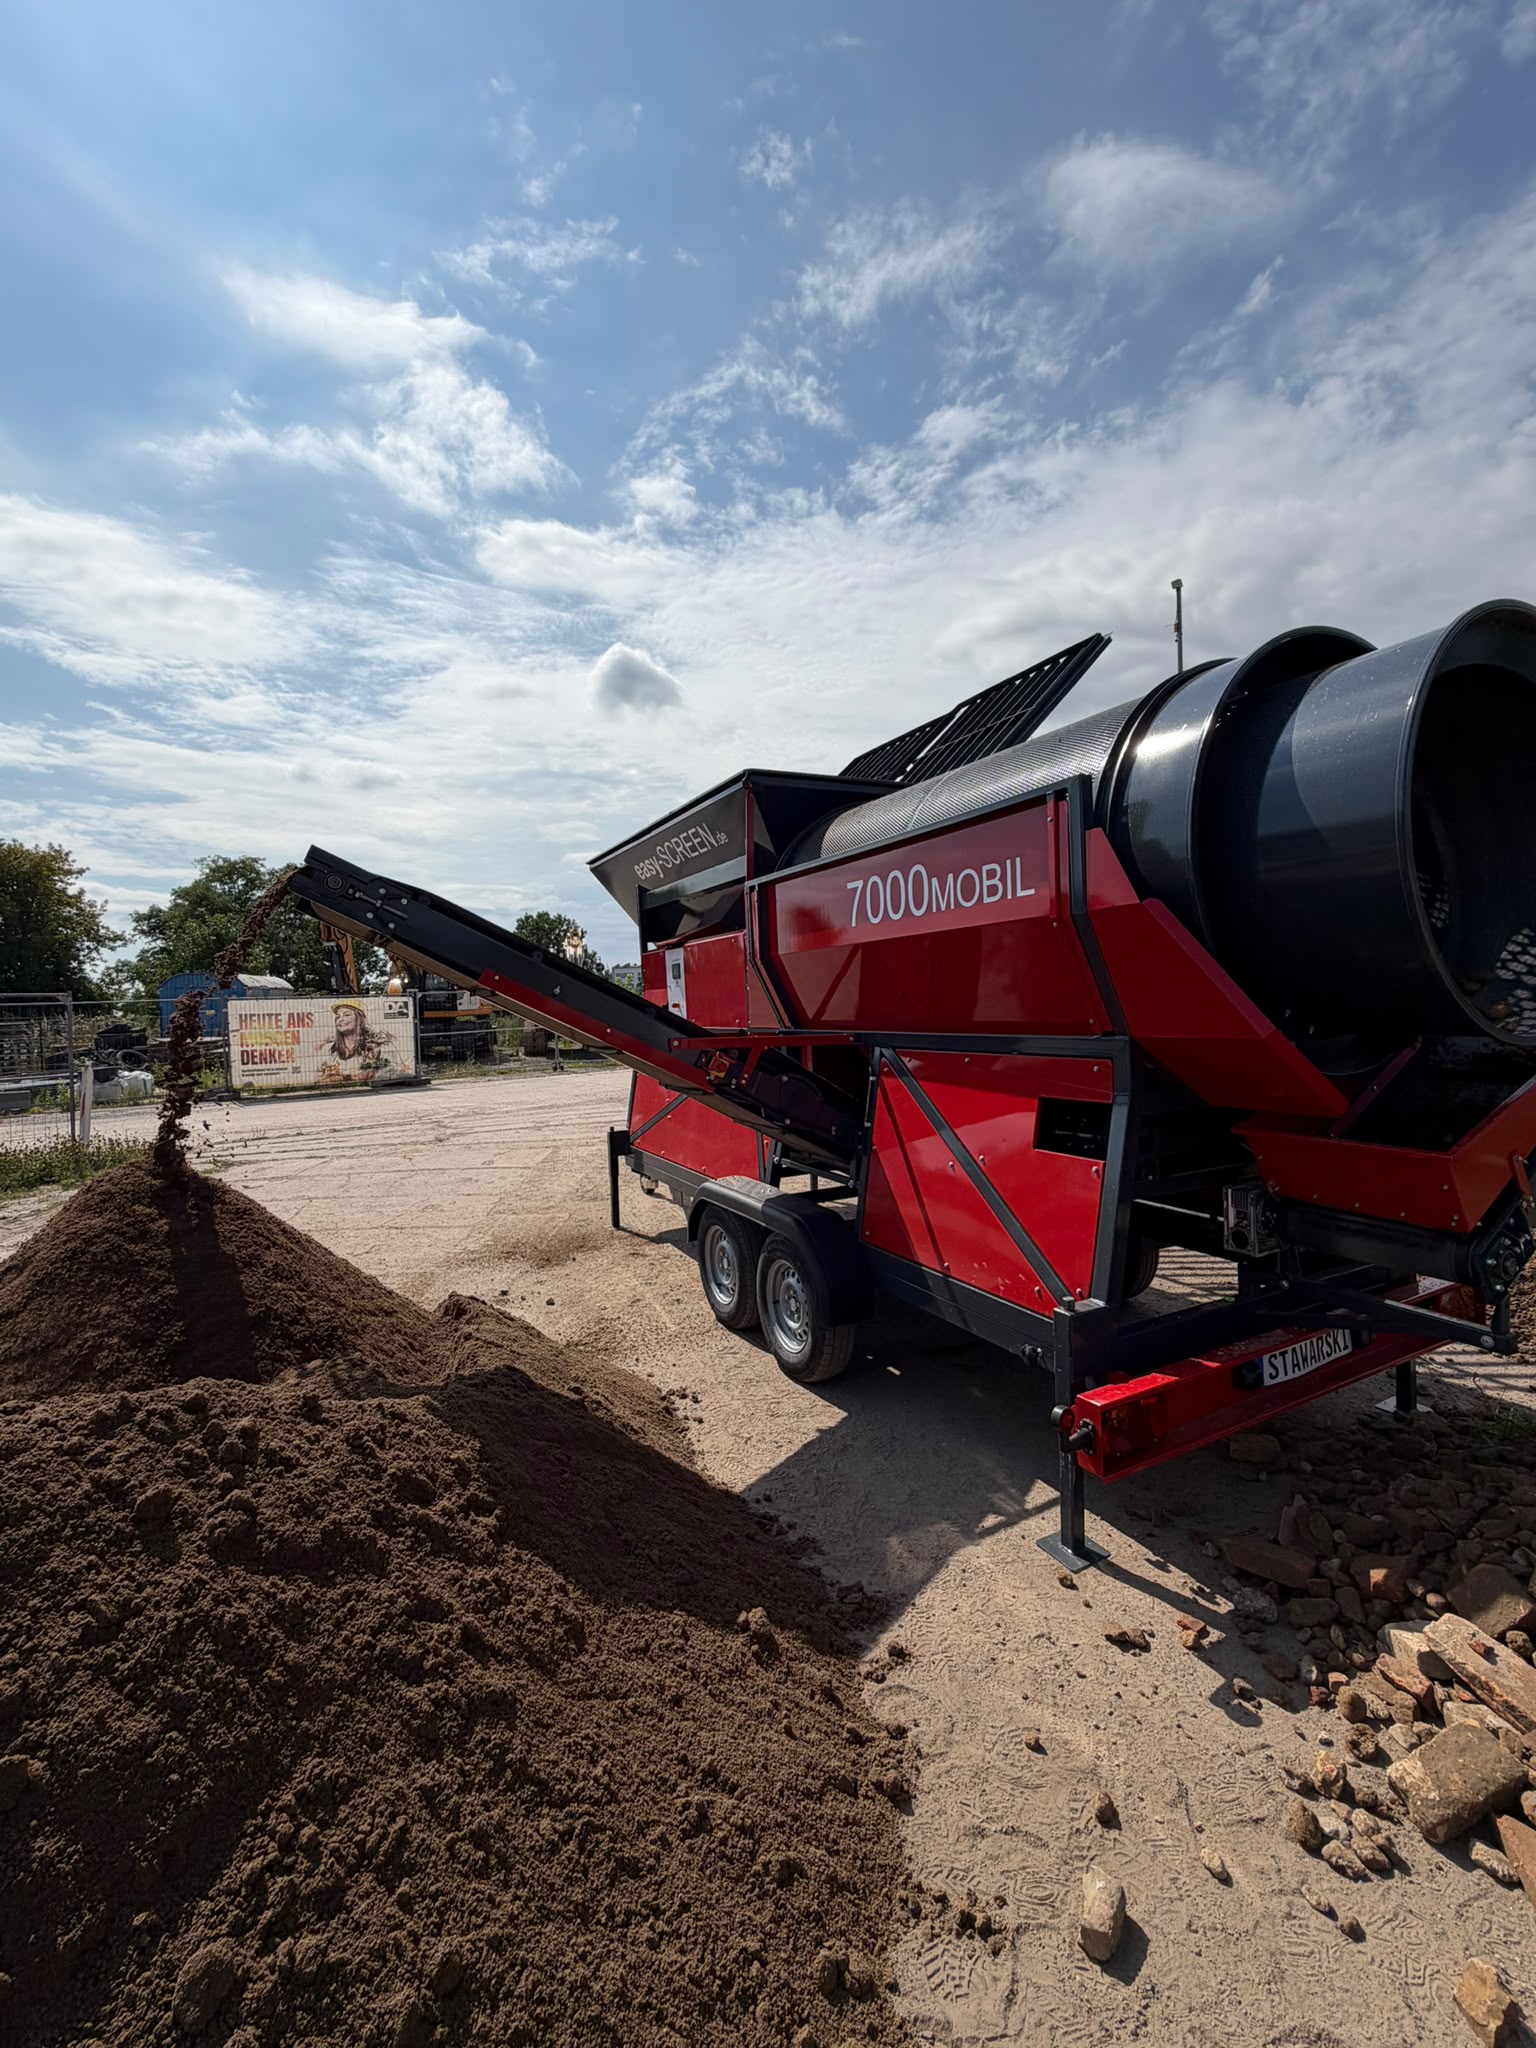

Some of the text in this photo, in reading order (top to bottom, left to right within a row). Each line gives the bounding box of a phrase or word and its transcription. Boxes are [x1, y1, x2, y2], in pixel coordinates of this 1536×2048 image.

[239, 1012, 314, 1030] HEUTE ANS
[1268, 1328, 1349, 1380] STAWARSKI
